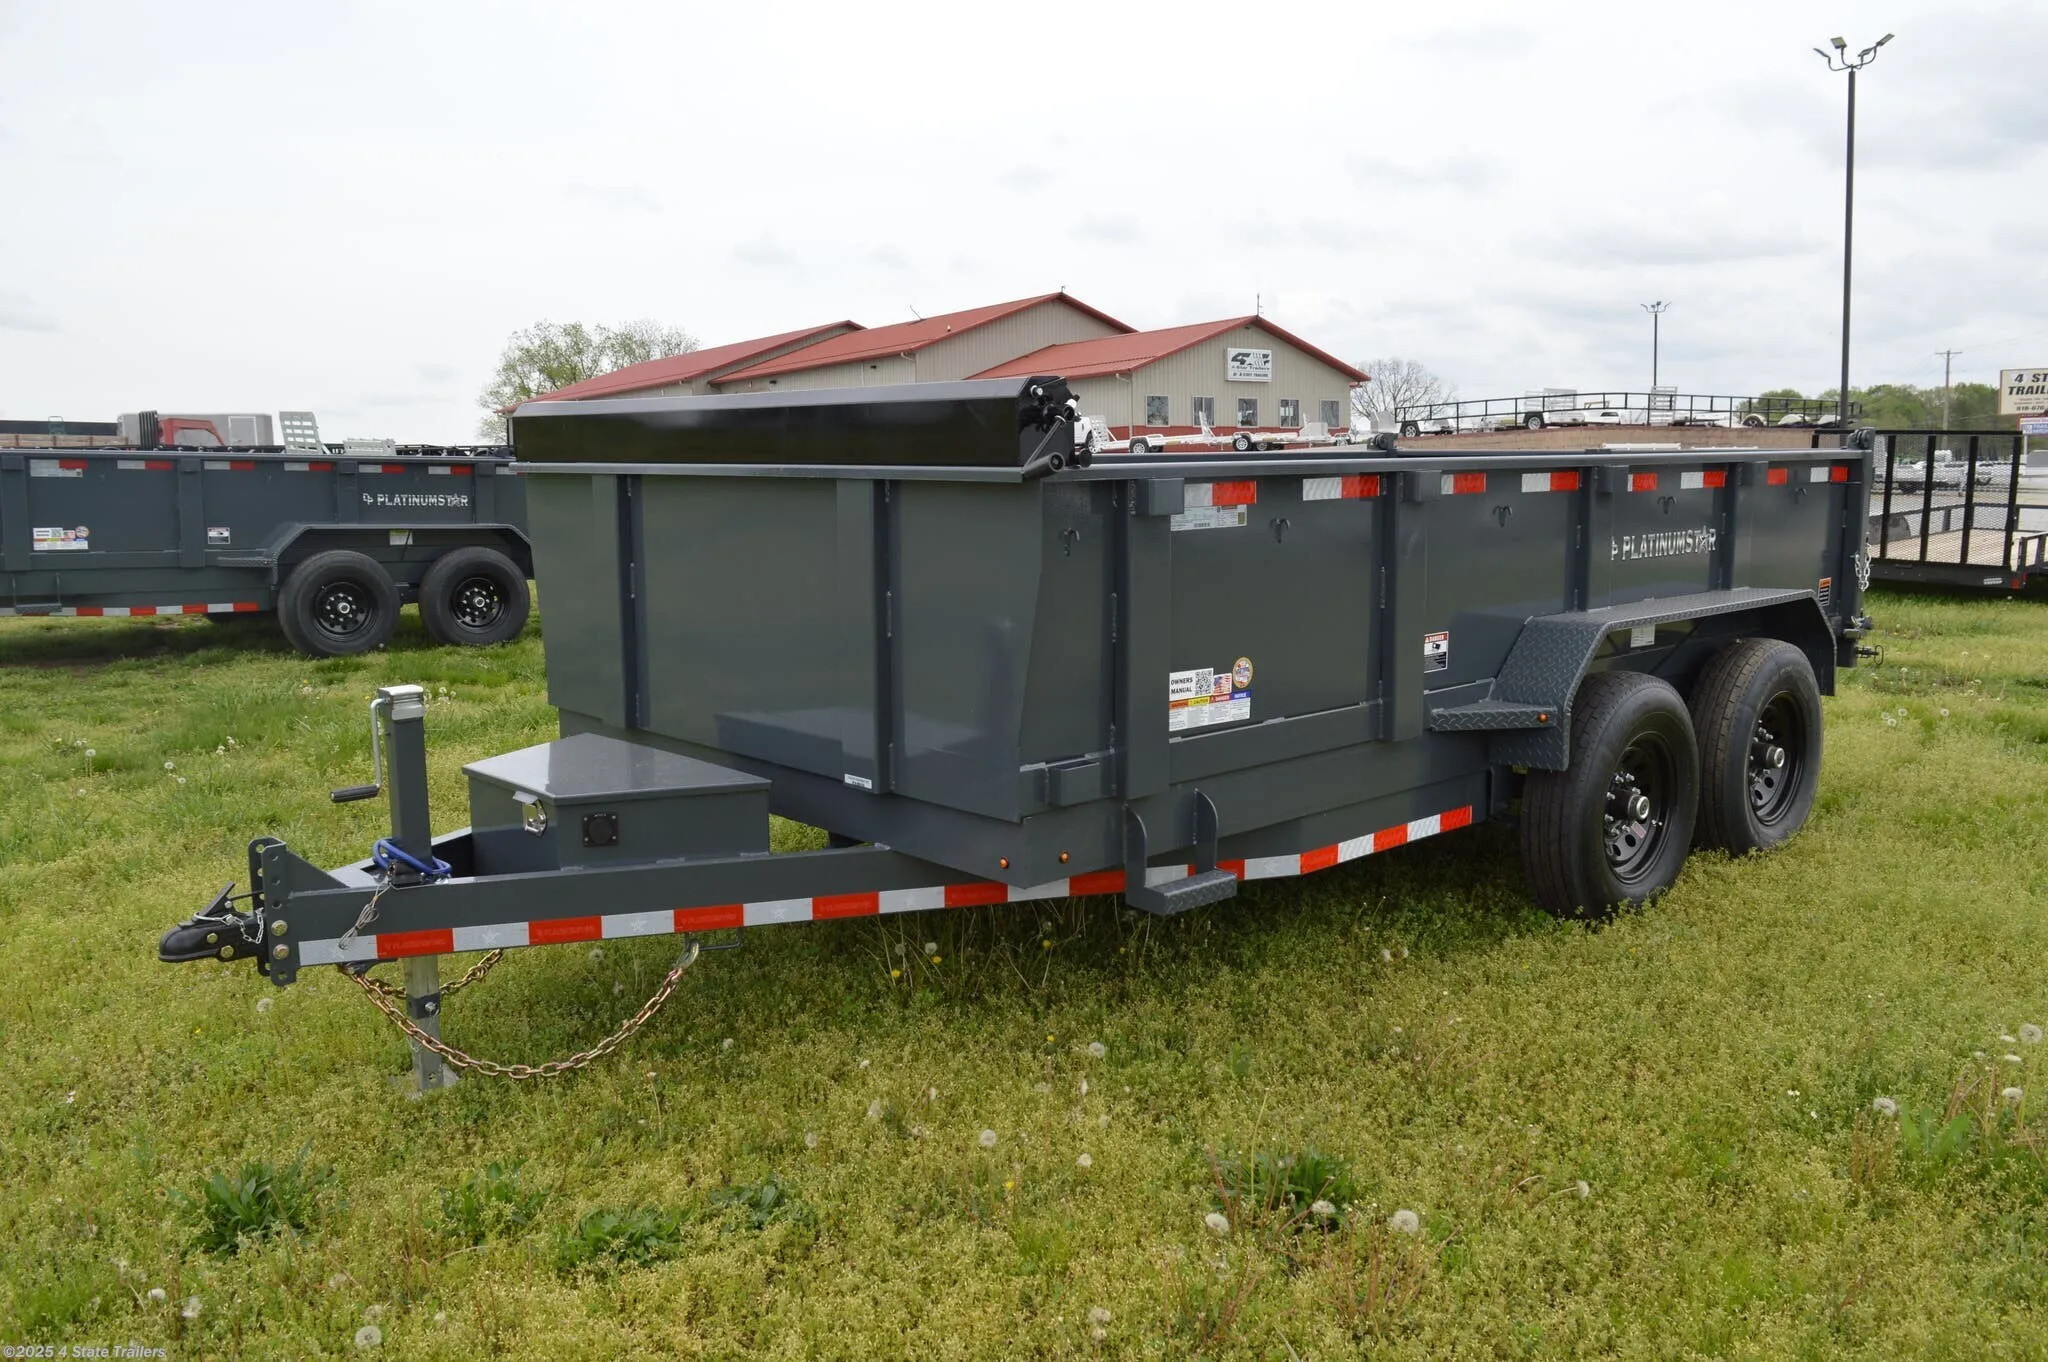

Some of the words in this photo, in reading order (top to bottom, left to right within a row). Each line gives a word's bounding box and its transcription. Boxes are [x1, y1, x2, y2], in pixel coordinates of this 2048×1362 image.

[2014, 373, 2024, 384] 4
[2008, 385, 2048, 396] TRAIL
[1171, 677, 1193, 686] OWNERS
